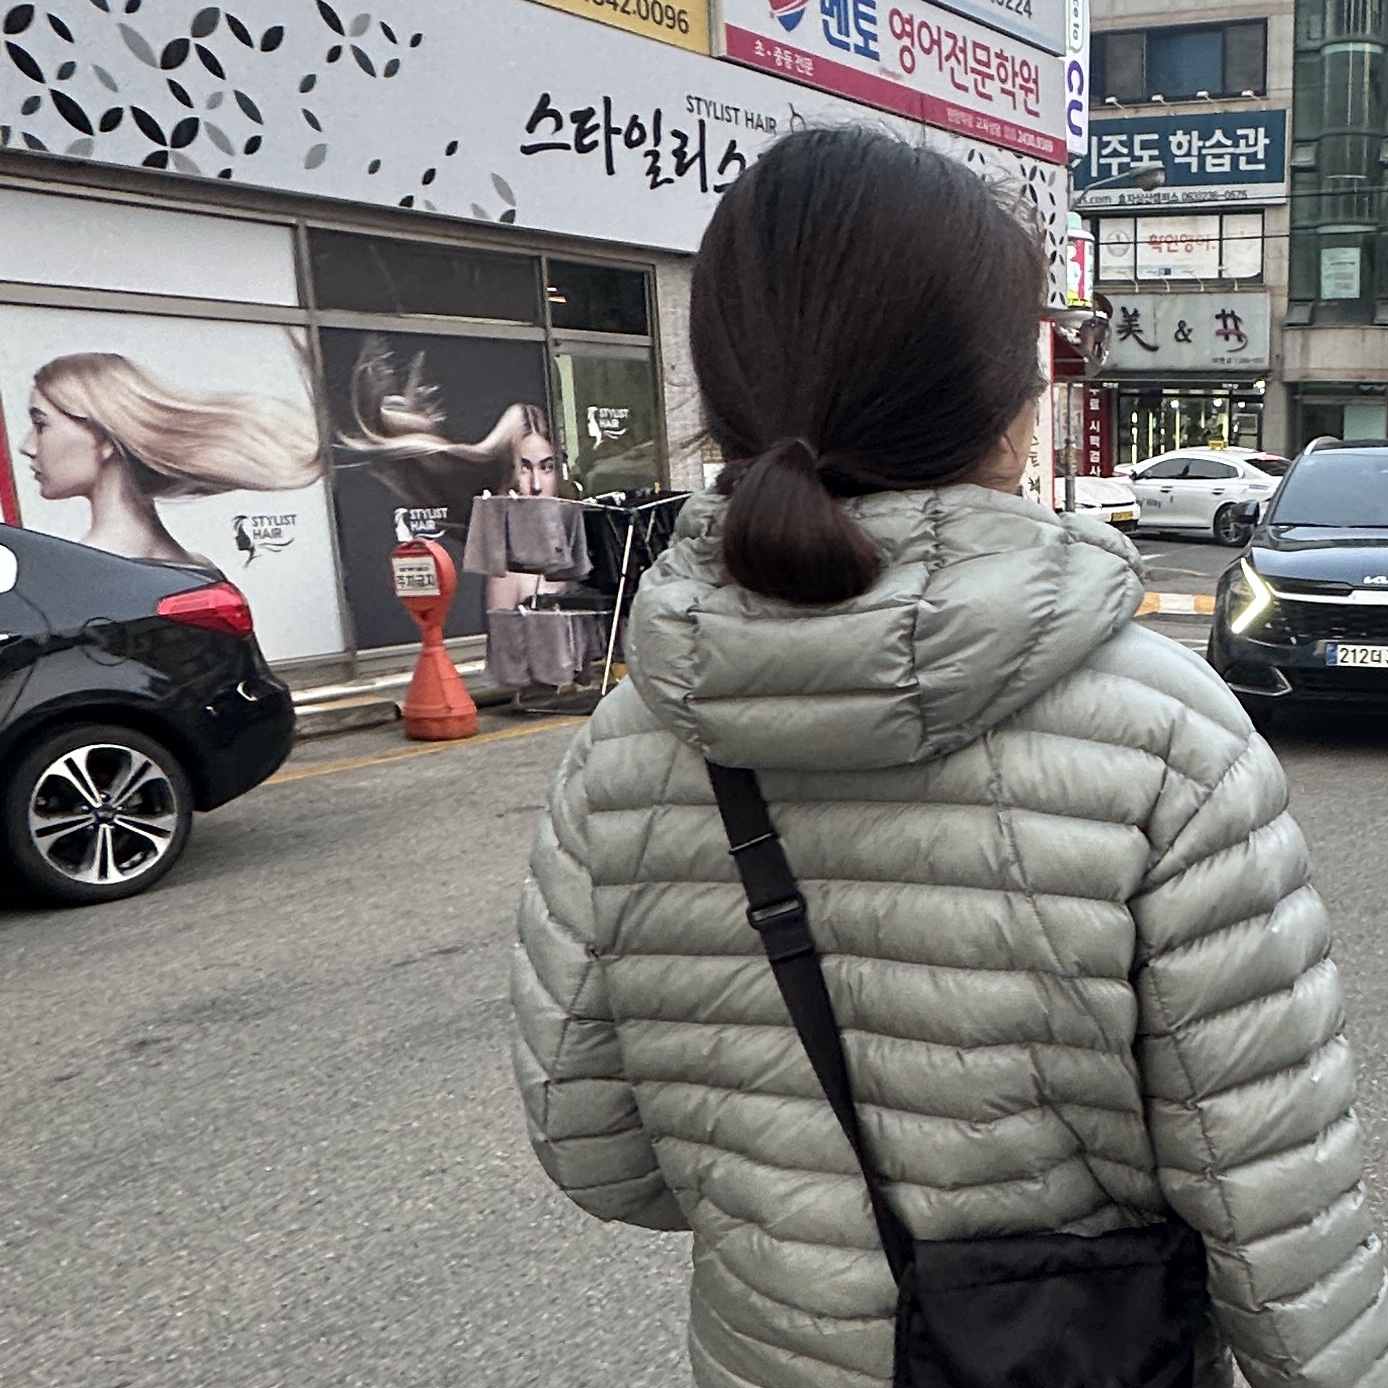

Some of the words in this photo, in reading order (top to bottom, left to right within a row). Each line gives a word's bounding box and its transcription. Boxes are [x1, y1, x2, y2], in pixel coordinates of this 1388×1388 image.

[592, 0, 689, 34] 2.0096
[888, 7, 1041, 118] 영어전문학원
[686, 95, 740, 126] STYLIST
[744, 112, 778, 134] HAIR
[1067, 60, 1084, 137] CU
[520, 92, 764, 193] 스타일리스
[1169, 127, 1270, 173] 학습관
[1174, 319, 1193, 343] &
[251, 514, 297, 527] STYLIST
[409, 508, 448, 520] STYLIST
[410, 520, 436, 531] HAIR
[252, 527, 282, 540] HAIR
